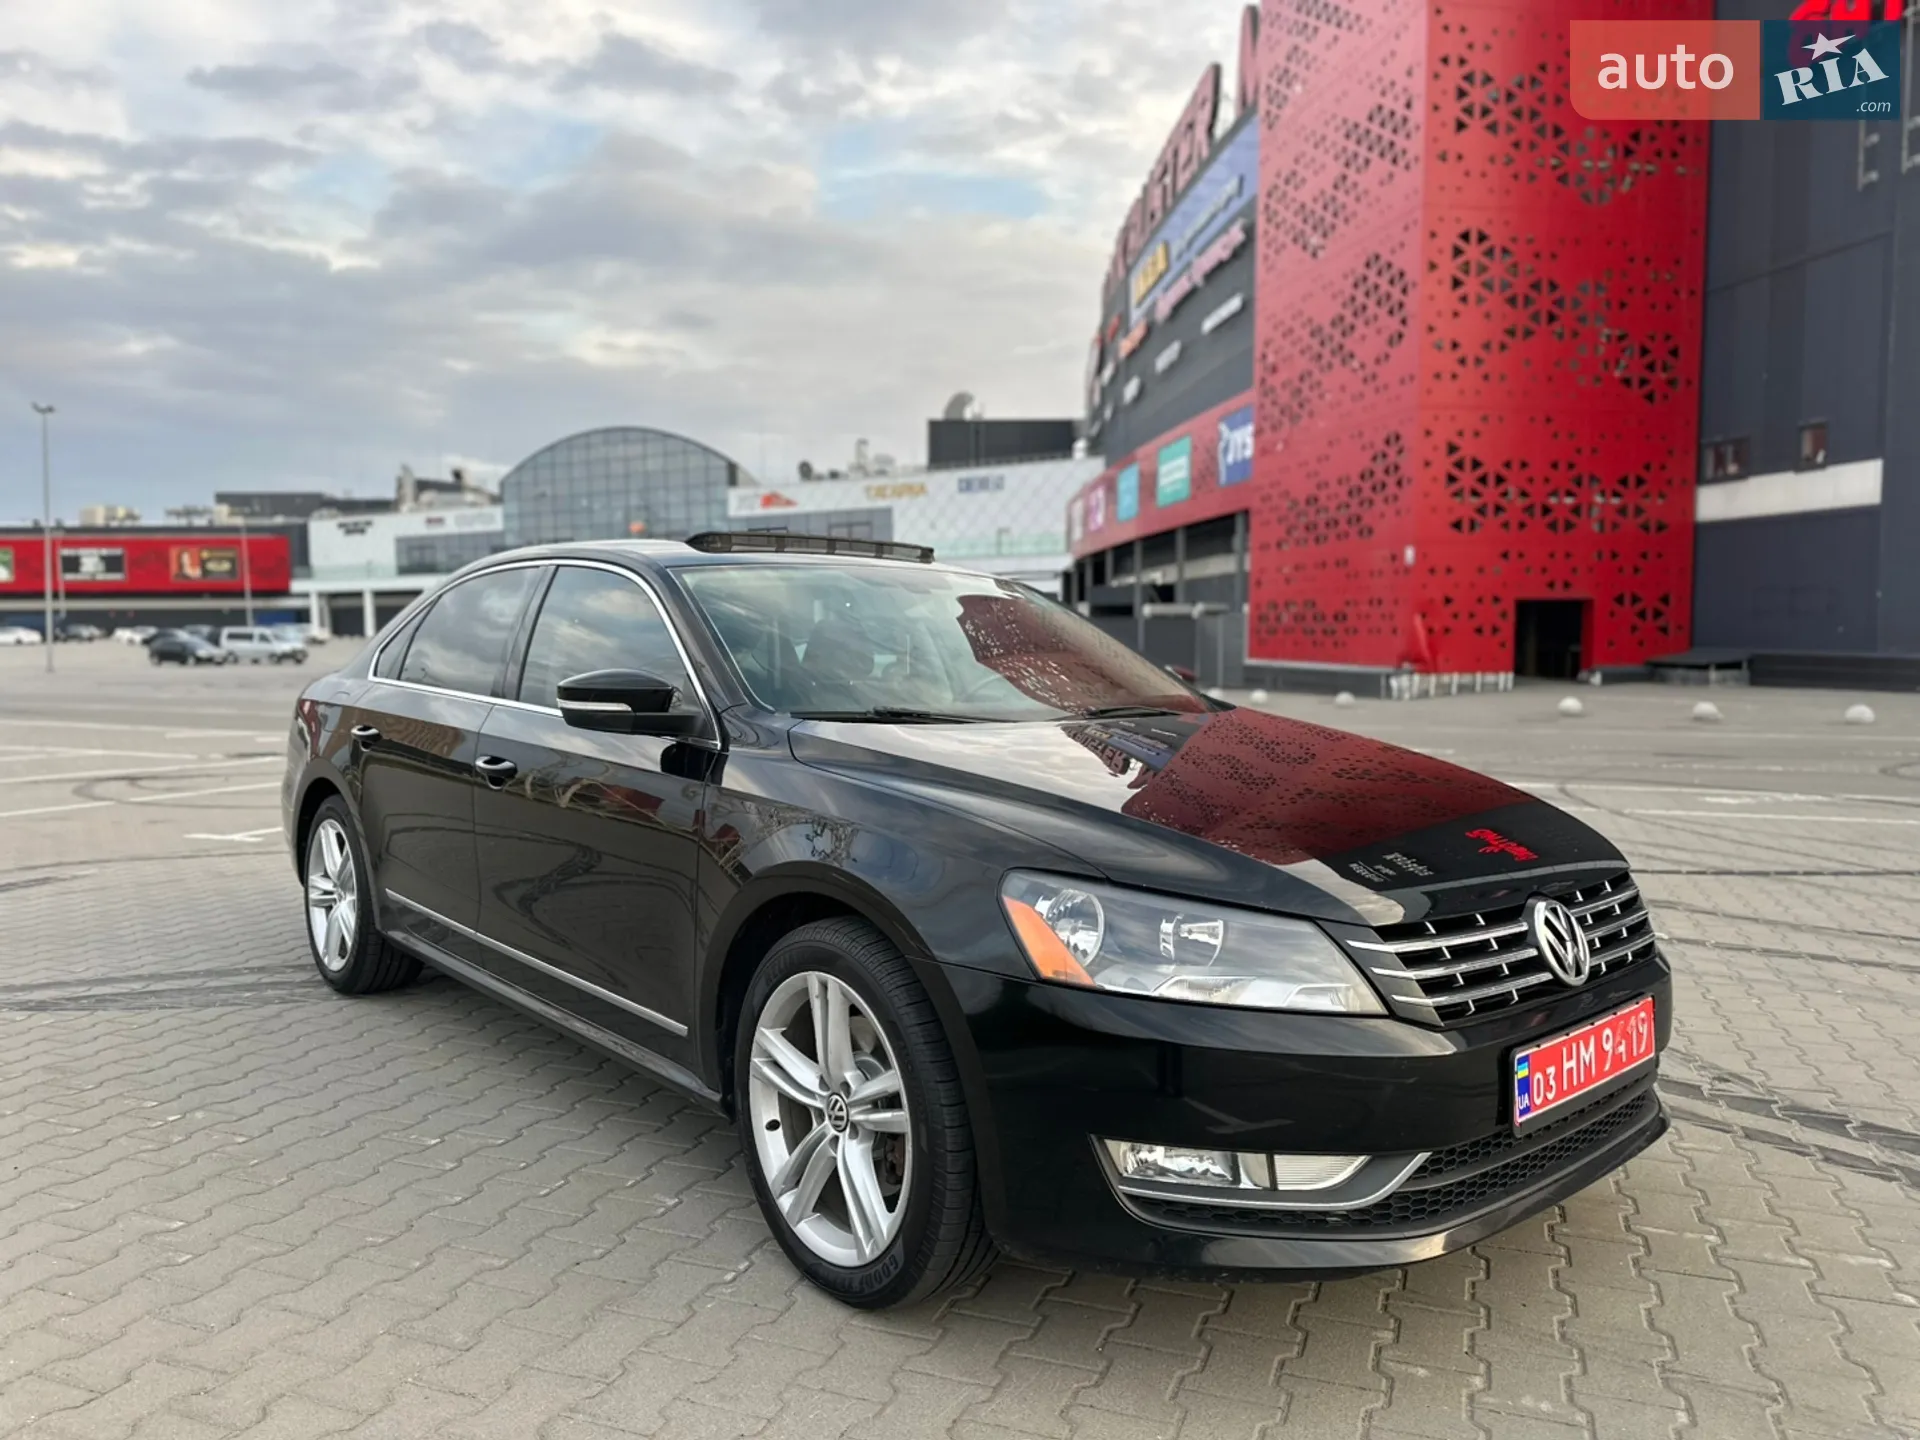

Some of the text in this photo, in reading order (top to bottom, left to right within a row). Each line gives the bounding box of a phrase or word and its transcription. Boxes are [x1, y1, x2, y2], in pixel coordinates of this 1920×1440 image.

[1533, 1065, 1556, 1105] 03
[1562, 1035, 1596, 1091] HM
[1518, 1093, 1530, 1109] UA
